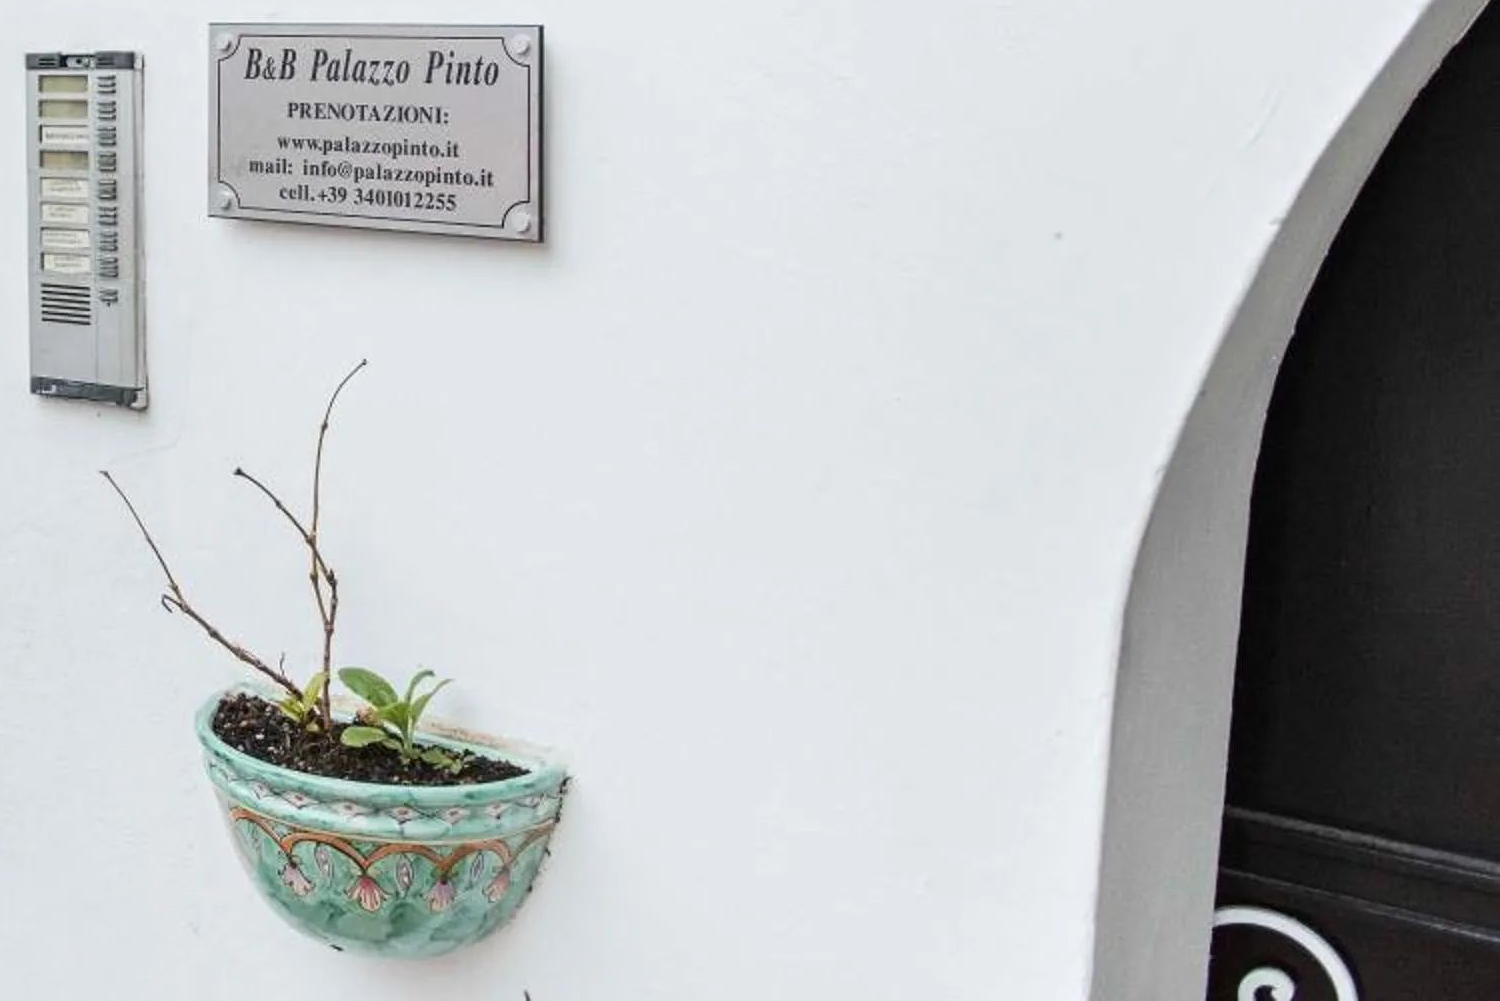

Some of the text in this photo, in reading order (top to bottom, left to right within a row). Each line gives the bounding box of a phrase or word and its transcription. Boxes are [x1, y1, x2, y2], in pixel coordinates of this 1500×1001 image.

[243, 48, 500, 87] B&B Palazzo Pinto
[287, 102, 449, 124] PRENOTAZIONI:
[277, 136, 460, 158] www.palazzopinto.it
[249, 159, 494, 187] mail: info@palazzopinto.it
[353, 189, 457, 212] 3401012255
